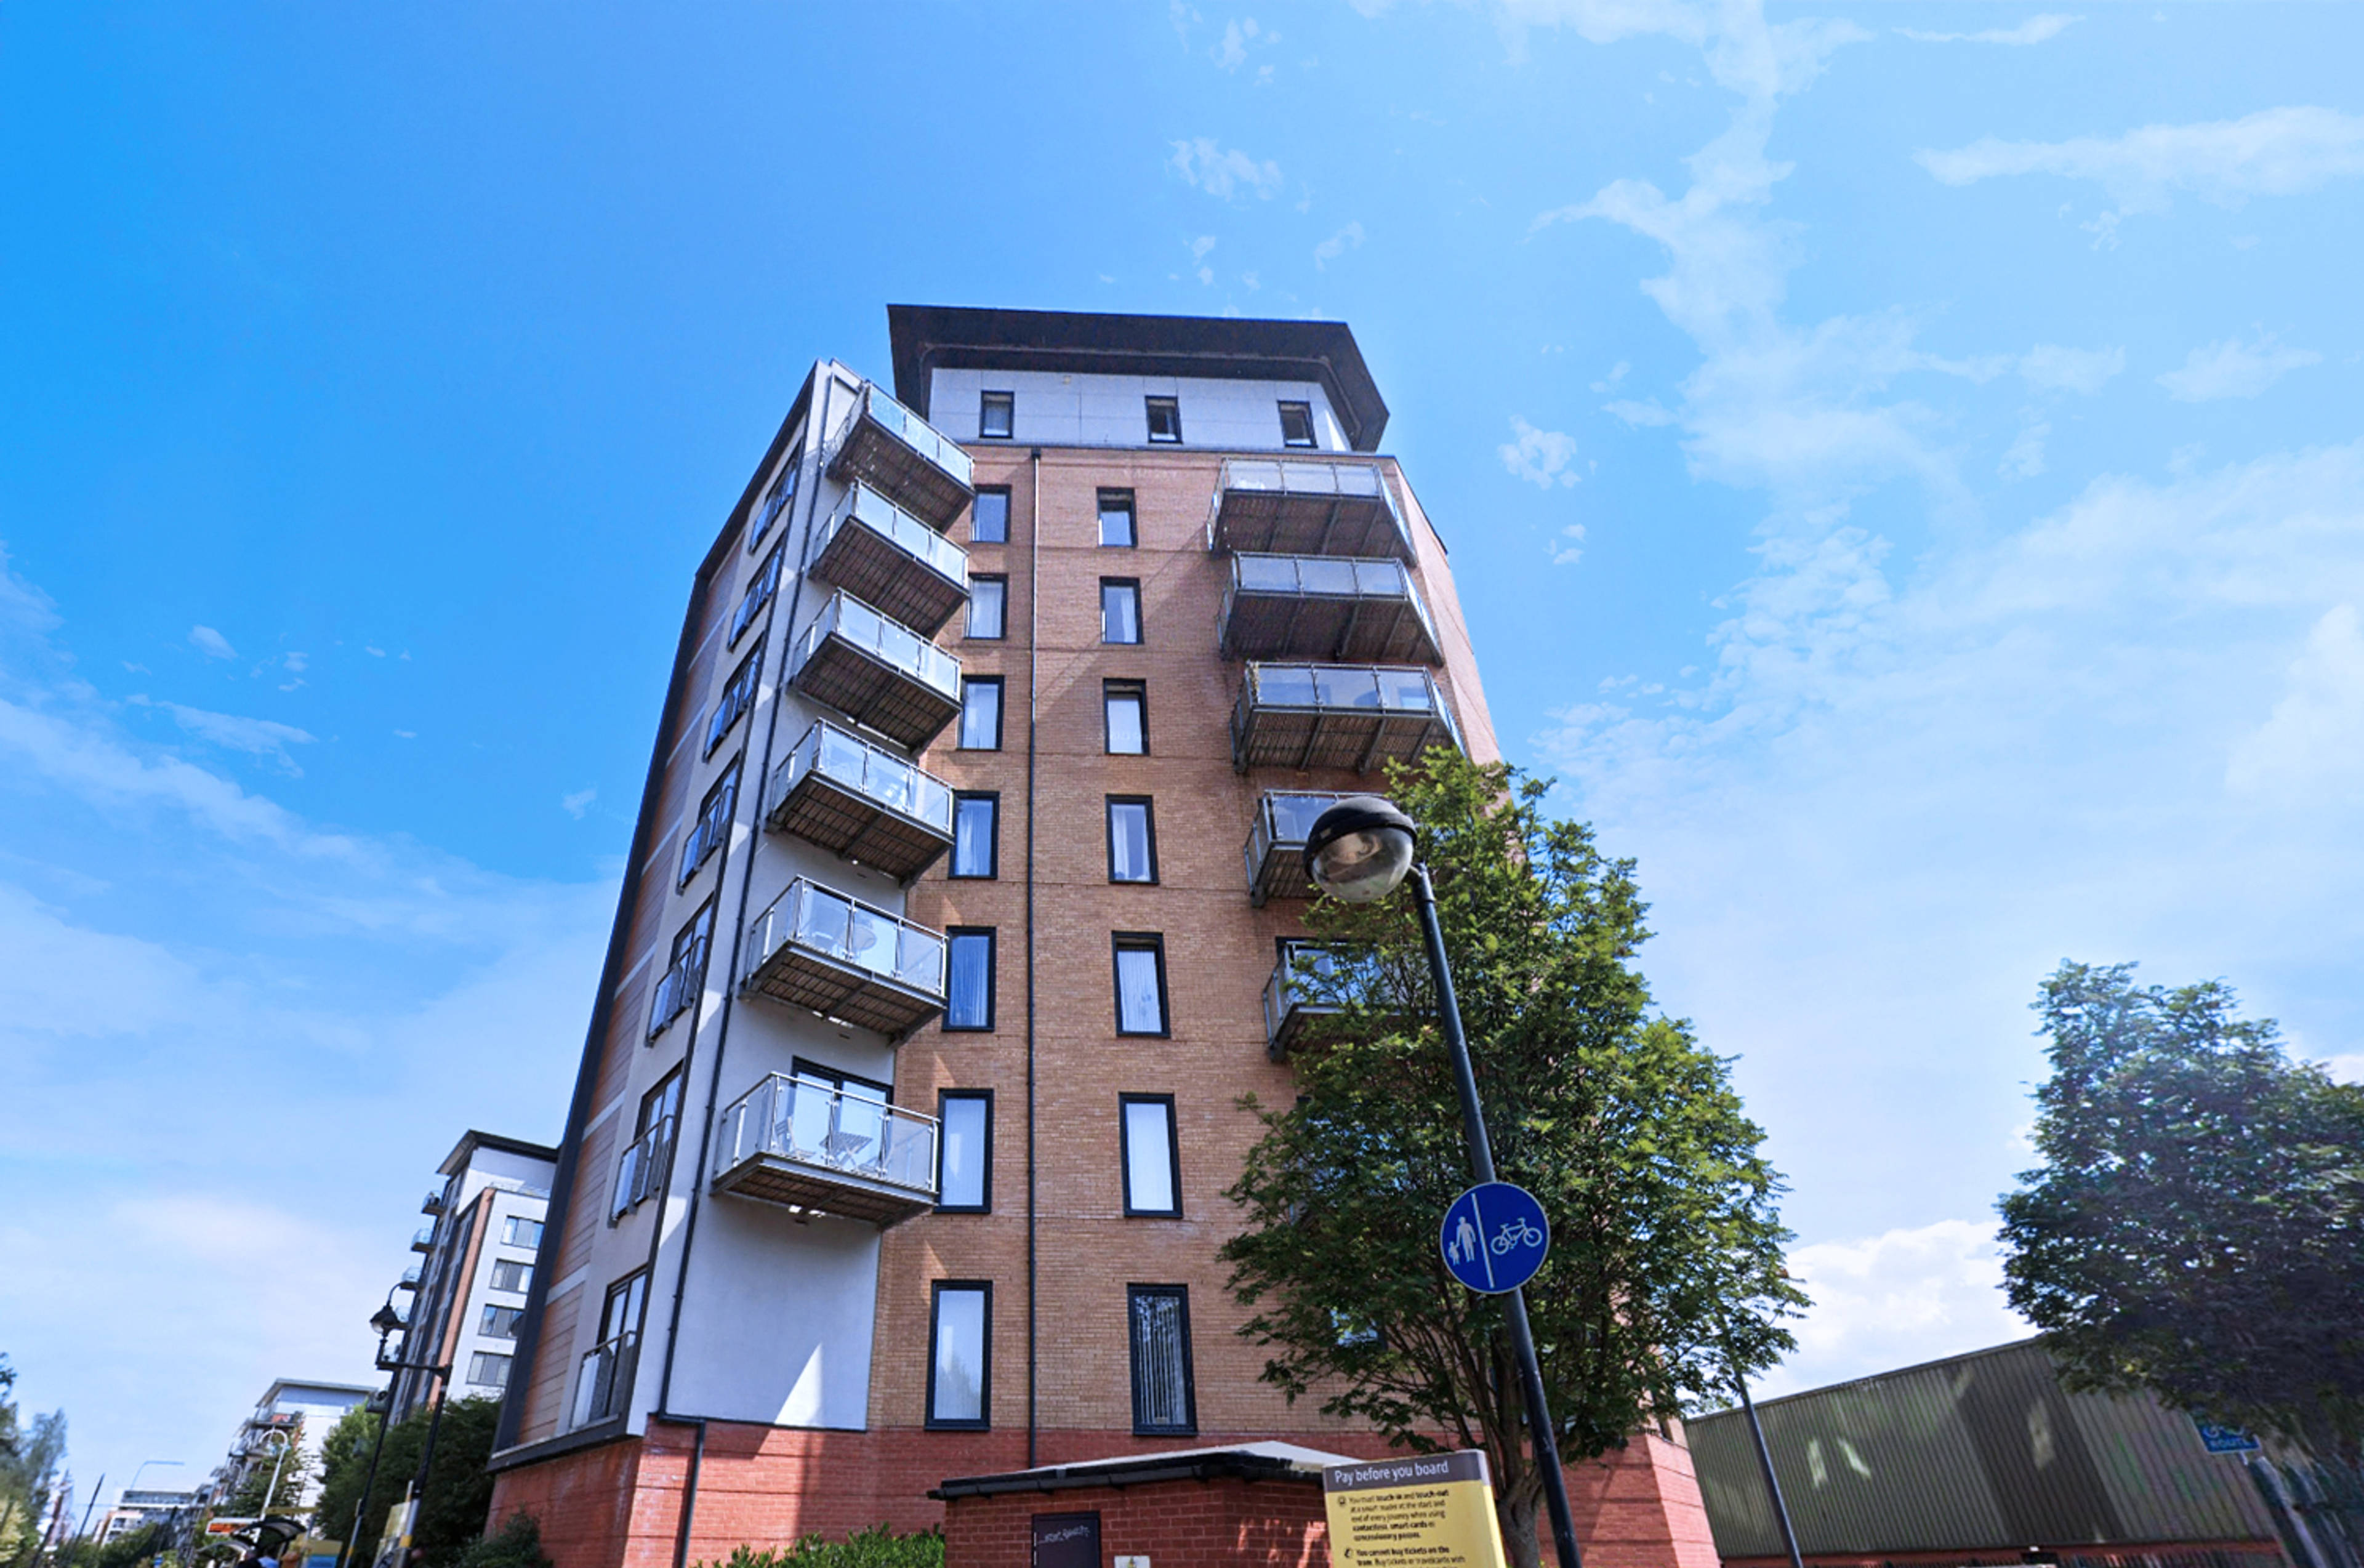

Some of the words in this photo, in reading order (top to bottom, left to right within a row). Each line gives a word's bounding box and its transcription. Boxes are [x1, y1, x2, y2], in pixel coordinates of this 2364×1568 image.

[1335, 1470, 1353, 1486] Pay
[1355, 1466, 1391, 1482] before
[1392, 1466, 1412, 1482] you
[1414, 1460, 1449, 1476] board
